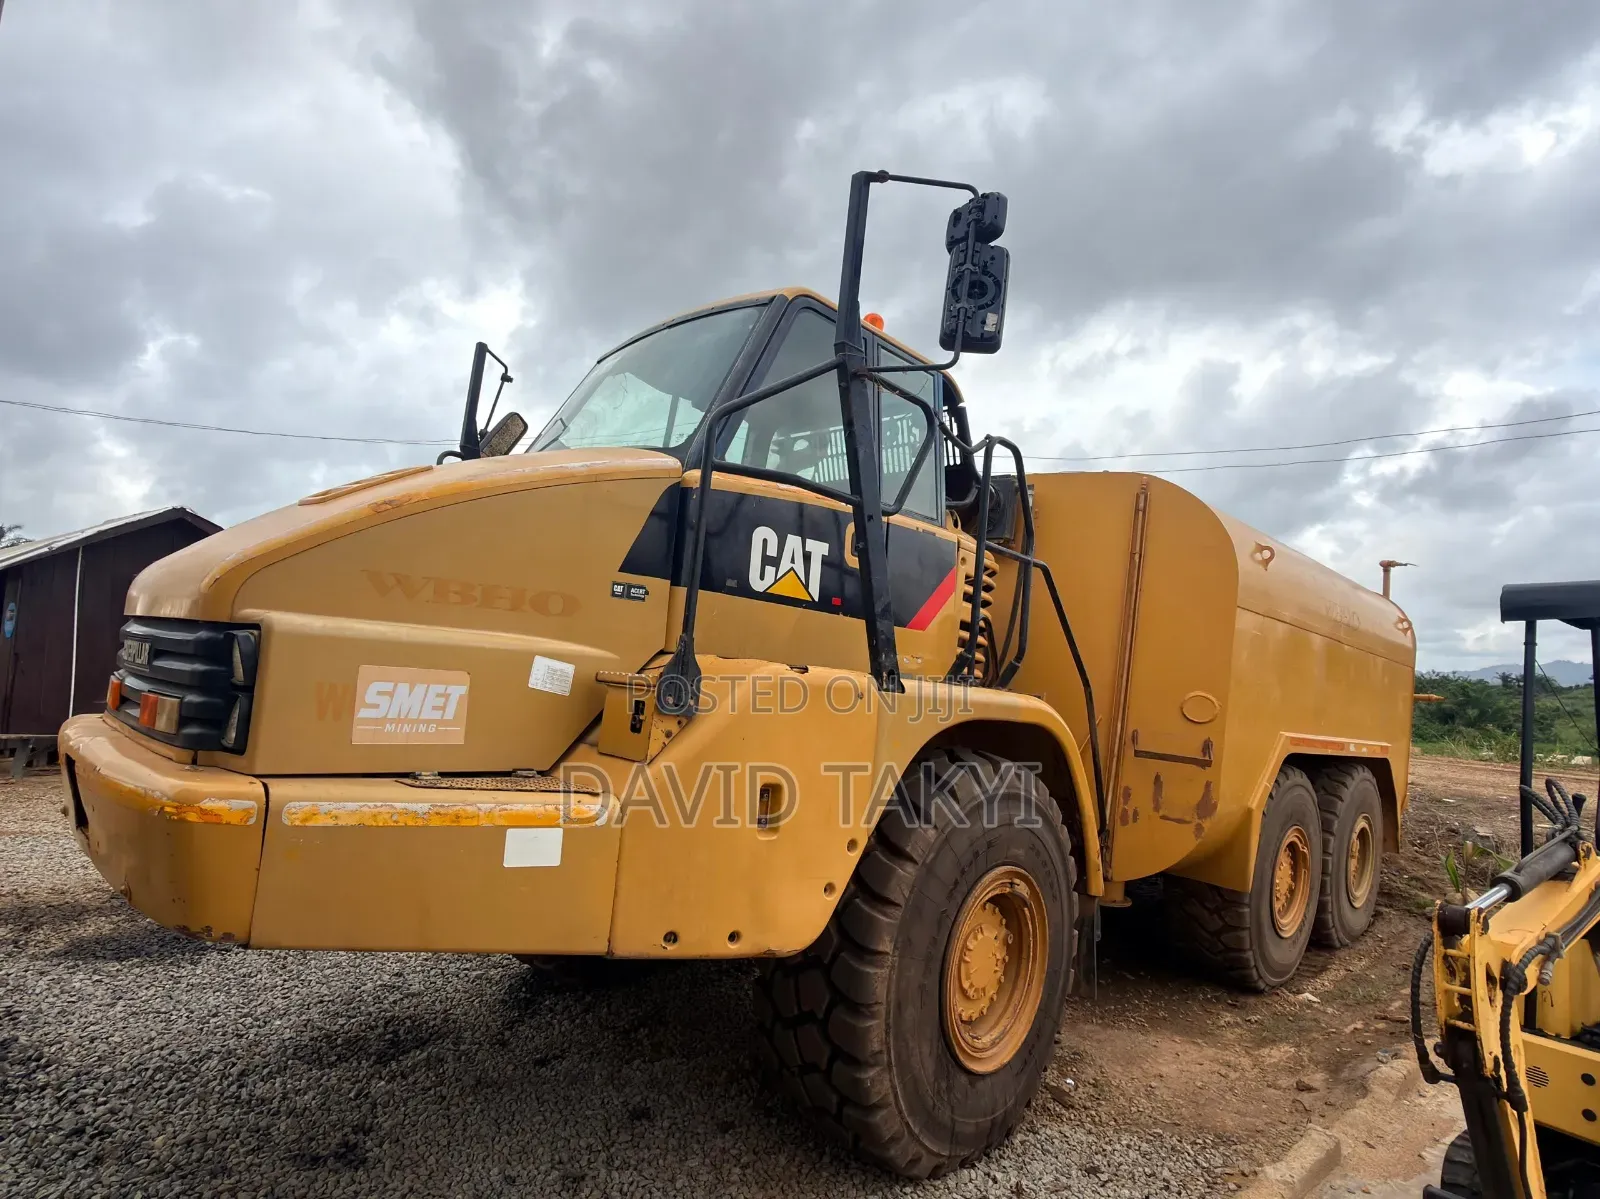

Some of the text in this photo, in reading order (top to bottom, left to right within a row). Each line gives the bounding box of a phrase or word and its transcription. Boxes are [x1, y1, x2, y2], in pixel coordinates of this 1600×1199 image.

[749, 526, 829, 602] CAT
[360, 569, 582, 617] WBHO
[613, 584, 624, 592] CAT
[357, 681, 468, 720] SMET
[384, 723, 437, 733] MINING
